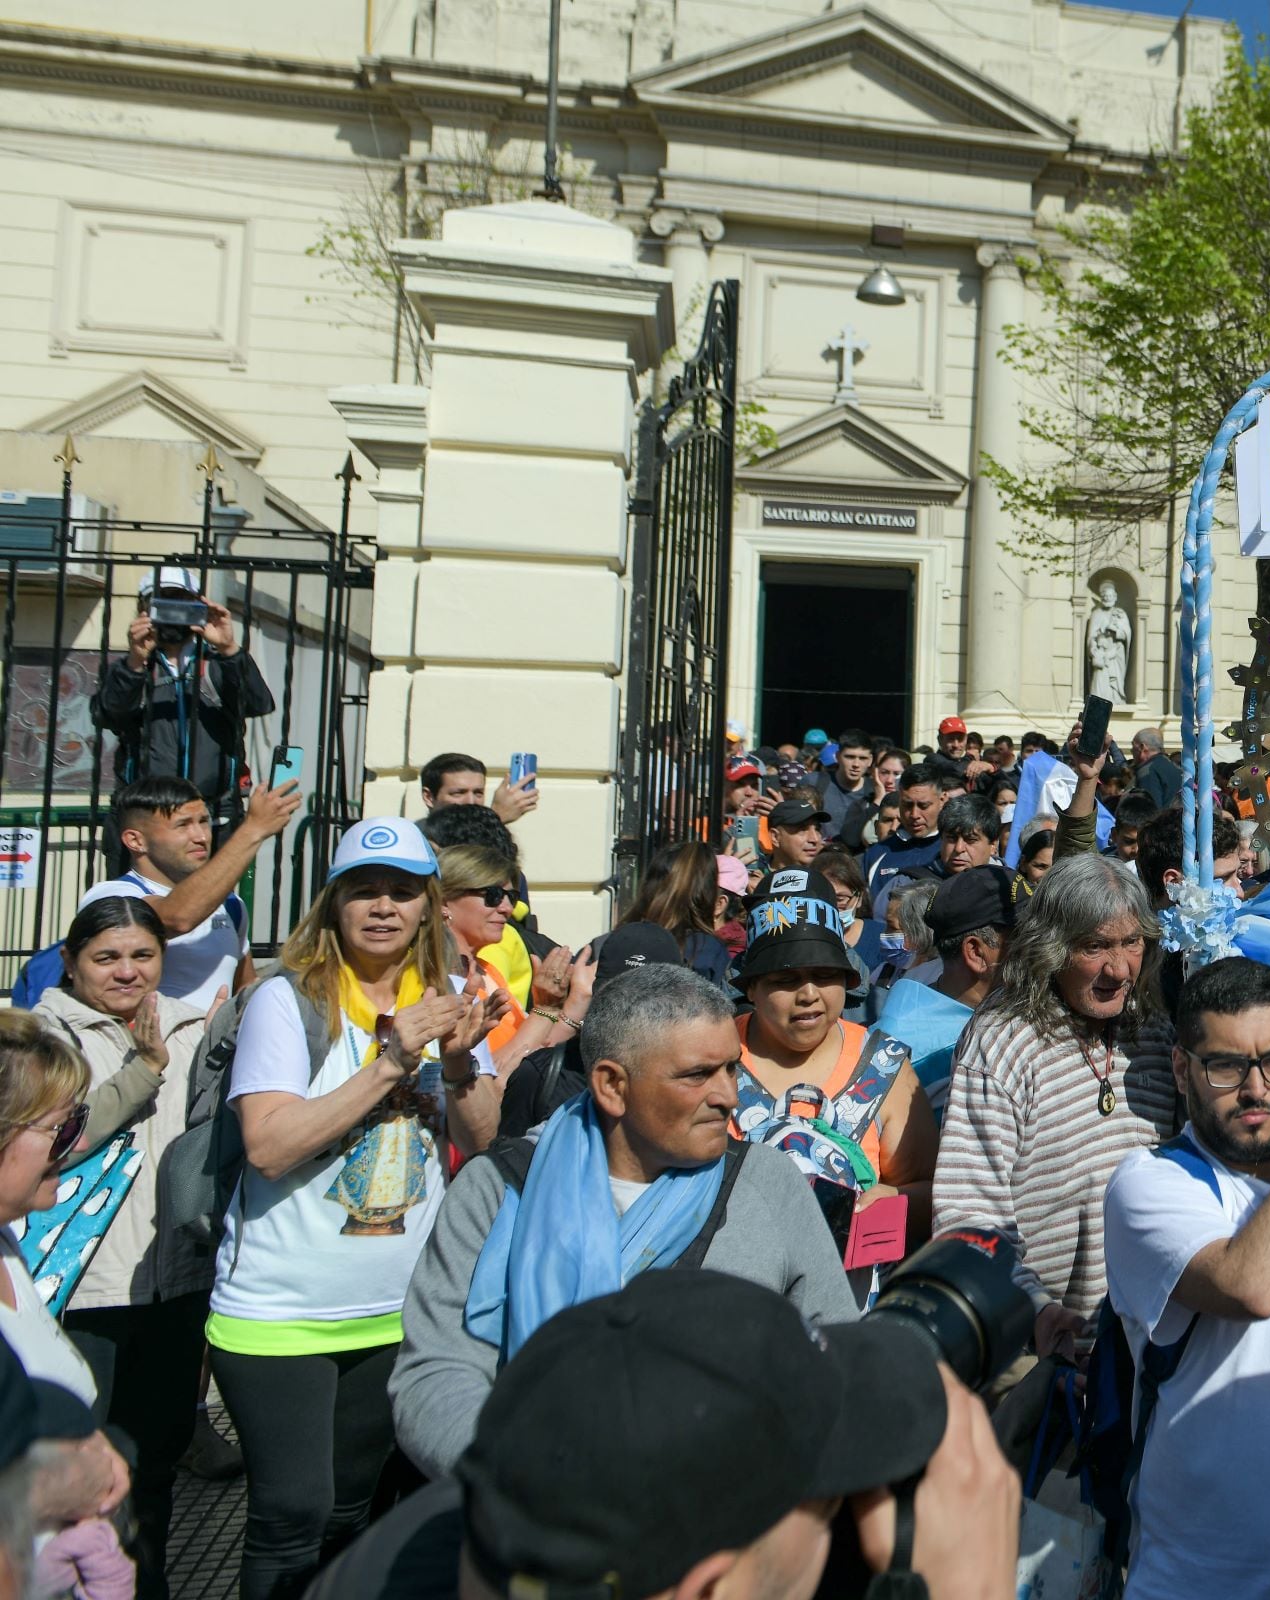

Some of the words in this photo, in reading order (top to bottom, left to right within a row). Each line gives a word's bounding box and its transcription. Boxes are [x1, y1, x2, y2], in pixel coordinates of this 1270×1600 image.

[763, 506, 830, 523] SANTUARIO
[830, 511, 853, 525] SAN
[854, 511, 916, 528] CAYETANO
[1246, 688, 1257, 721] Virgen
[780, 874, 799, 882] NIKE
[748, 896, 845, 944] ENTI
